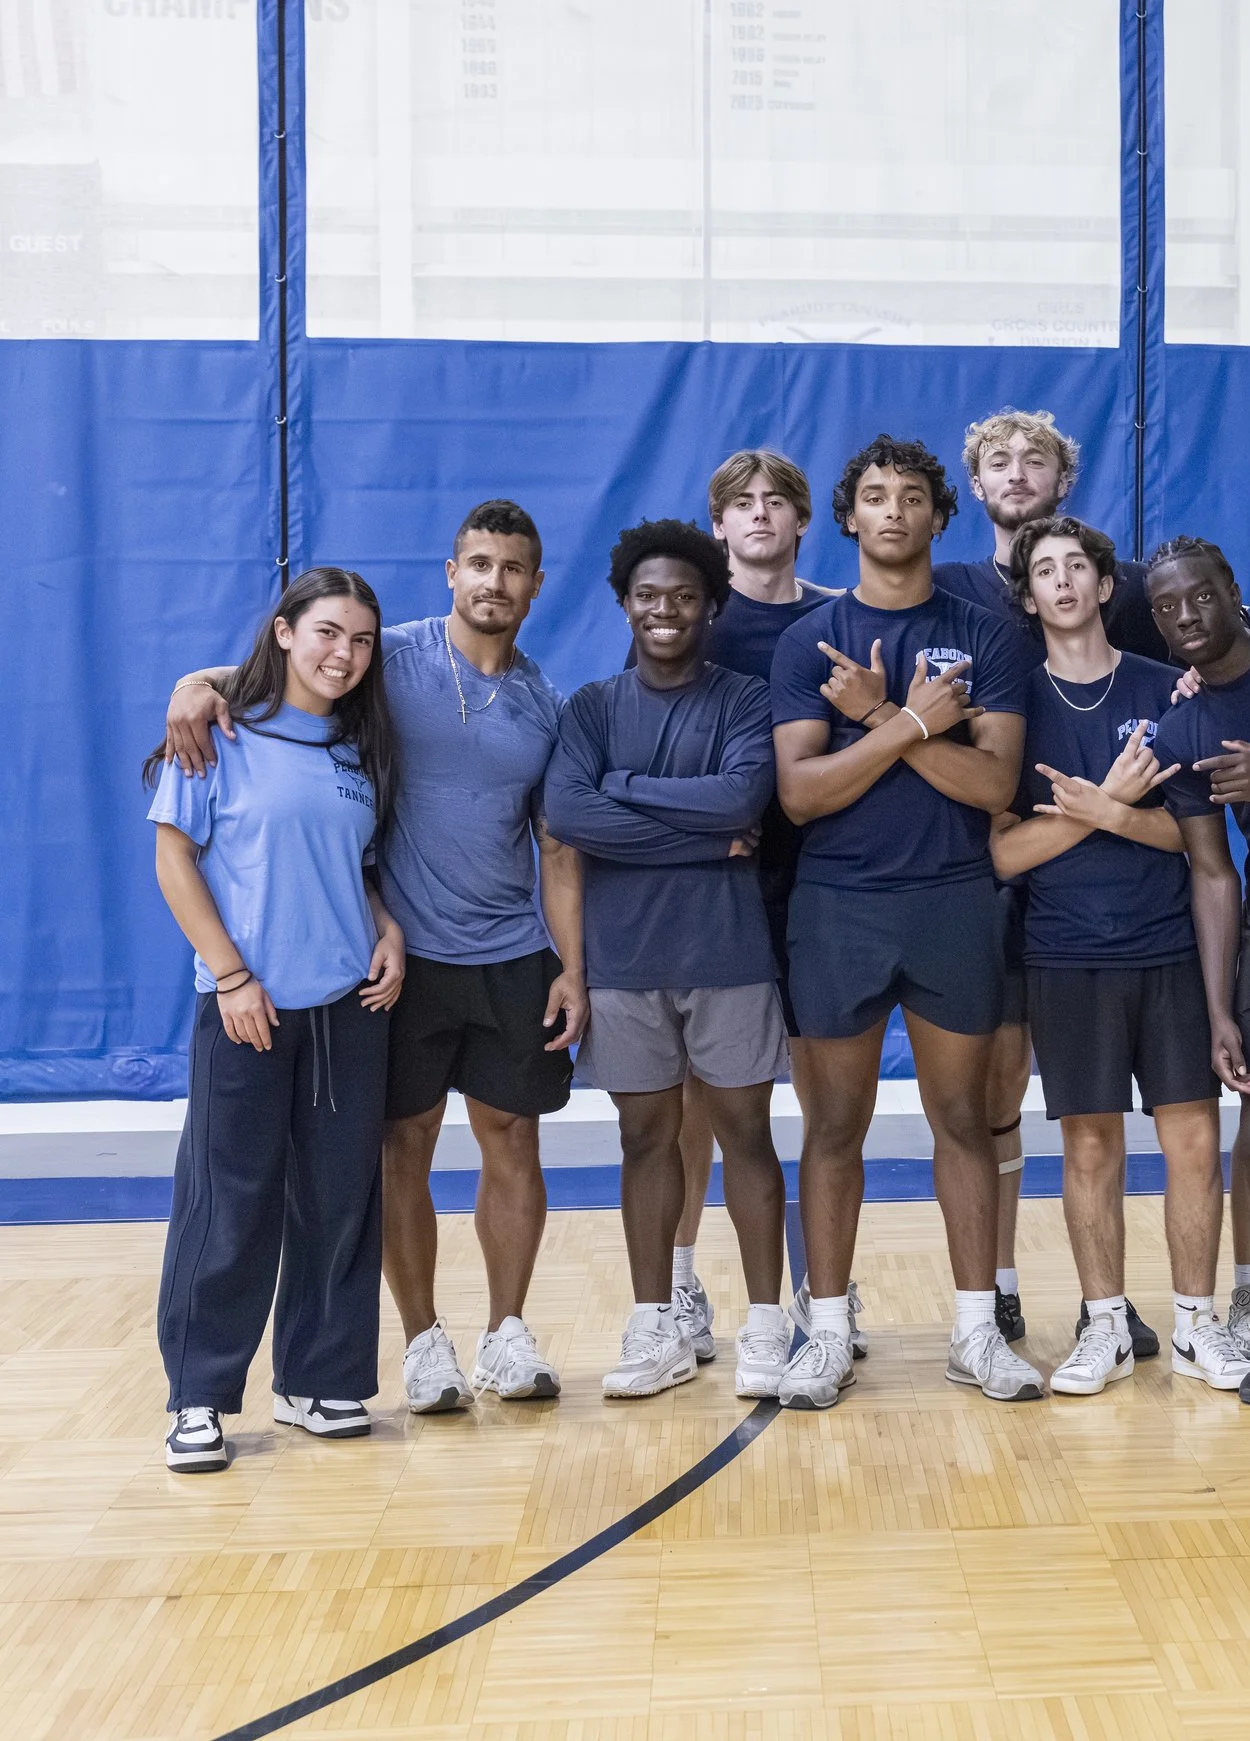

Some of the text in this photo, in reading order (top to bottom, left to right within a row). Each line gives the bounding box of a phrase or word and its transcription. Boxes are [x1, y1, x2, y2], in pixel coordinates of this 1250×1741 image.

[10, 235, 83, 252] GUEST
[1053, 319, 1119, 333] COUNTR
[916, 647, 973, 666] EABOD
[336, 785, 376, 808] TANNE
